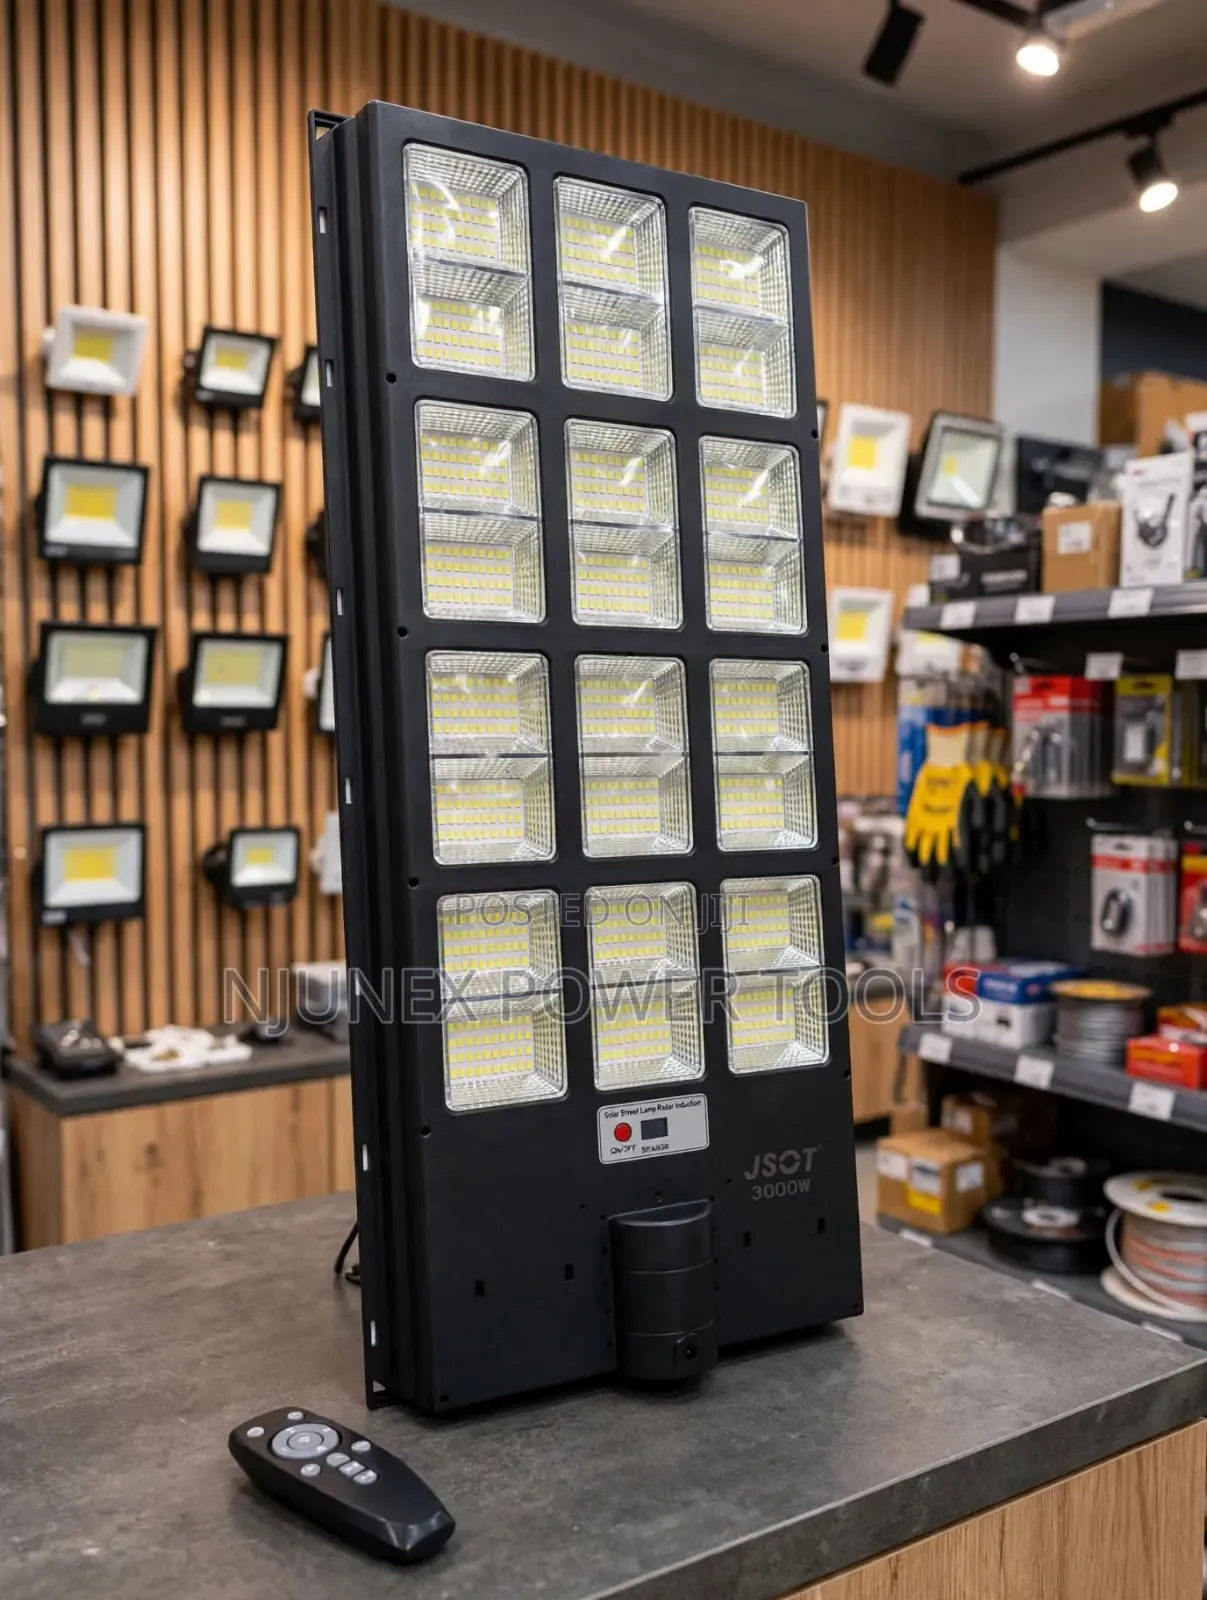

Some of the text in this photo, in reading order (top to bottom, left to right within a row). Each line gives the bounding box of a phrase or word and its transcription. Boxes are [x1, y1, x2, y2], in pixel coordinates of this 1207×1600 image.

[604, 1110, 619, 1119] Solar
[620, 1108, 639, 1117] Street
[640, 1106, 656, 1115] Lamp
[657, 1103, 674, 1111] Radar
[744, 1146, 817, 1180] JSOT
[752, 1178, 810, 1200] 3000W
